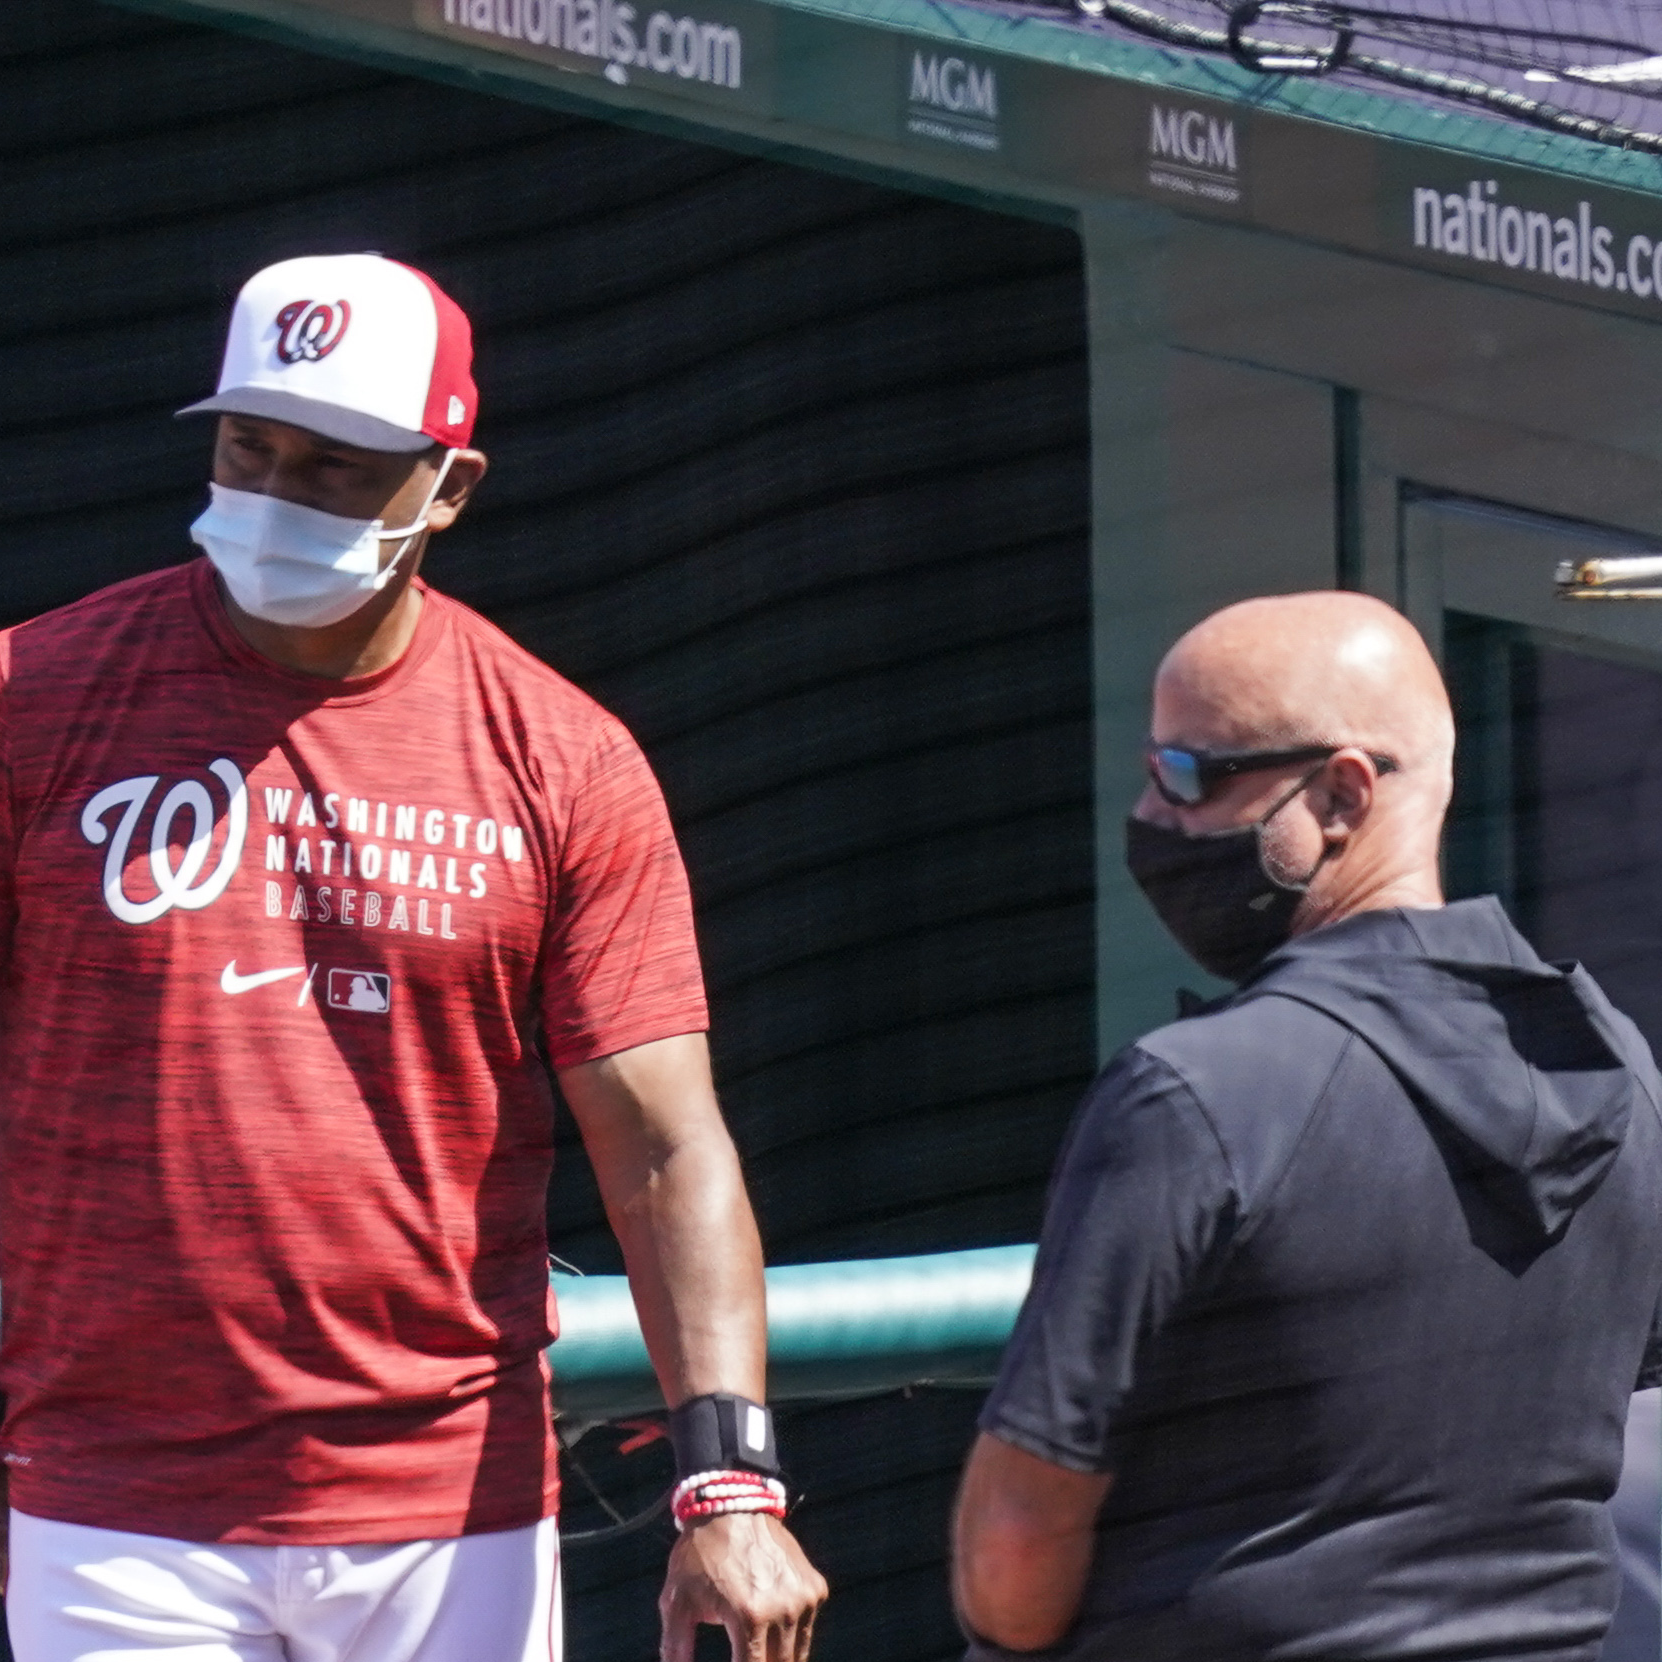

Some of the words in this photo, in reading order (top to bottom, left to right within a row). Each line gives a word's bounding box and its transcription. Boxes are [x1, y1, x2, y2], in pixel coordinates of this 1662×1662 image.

[908, 50, 998, 118] MGM
[1149, 105, 1237, 171] MGM
[276, 299, 351, 364] W
[81, 758, 249, 925] W
[265, 787, 524, 862] WASHINGTON
[265, 835, 487, 898] NATIONALS
[265, 881, 457, 940] BASEBALL
